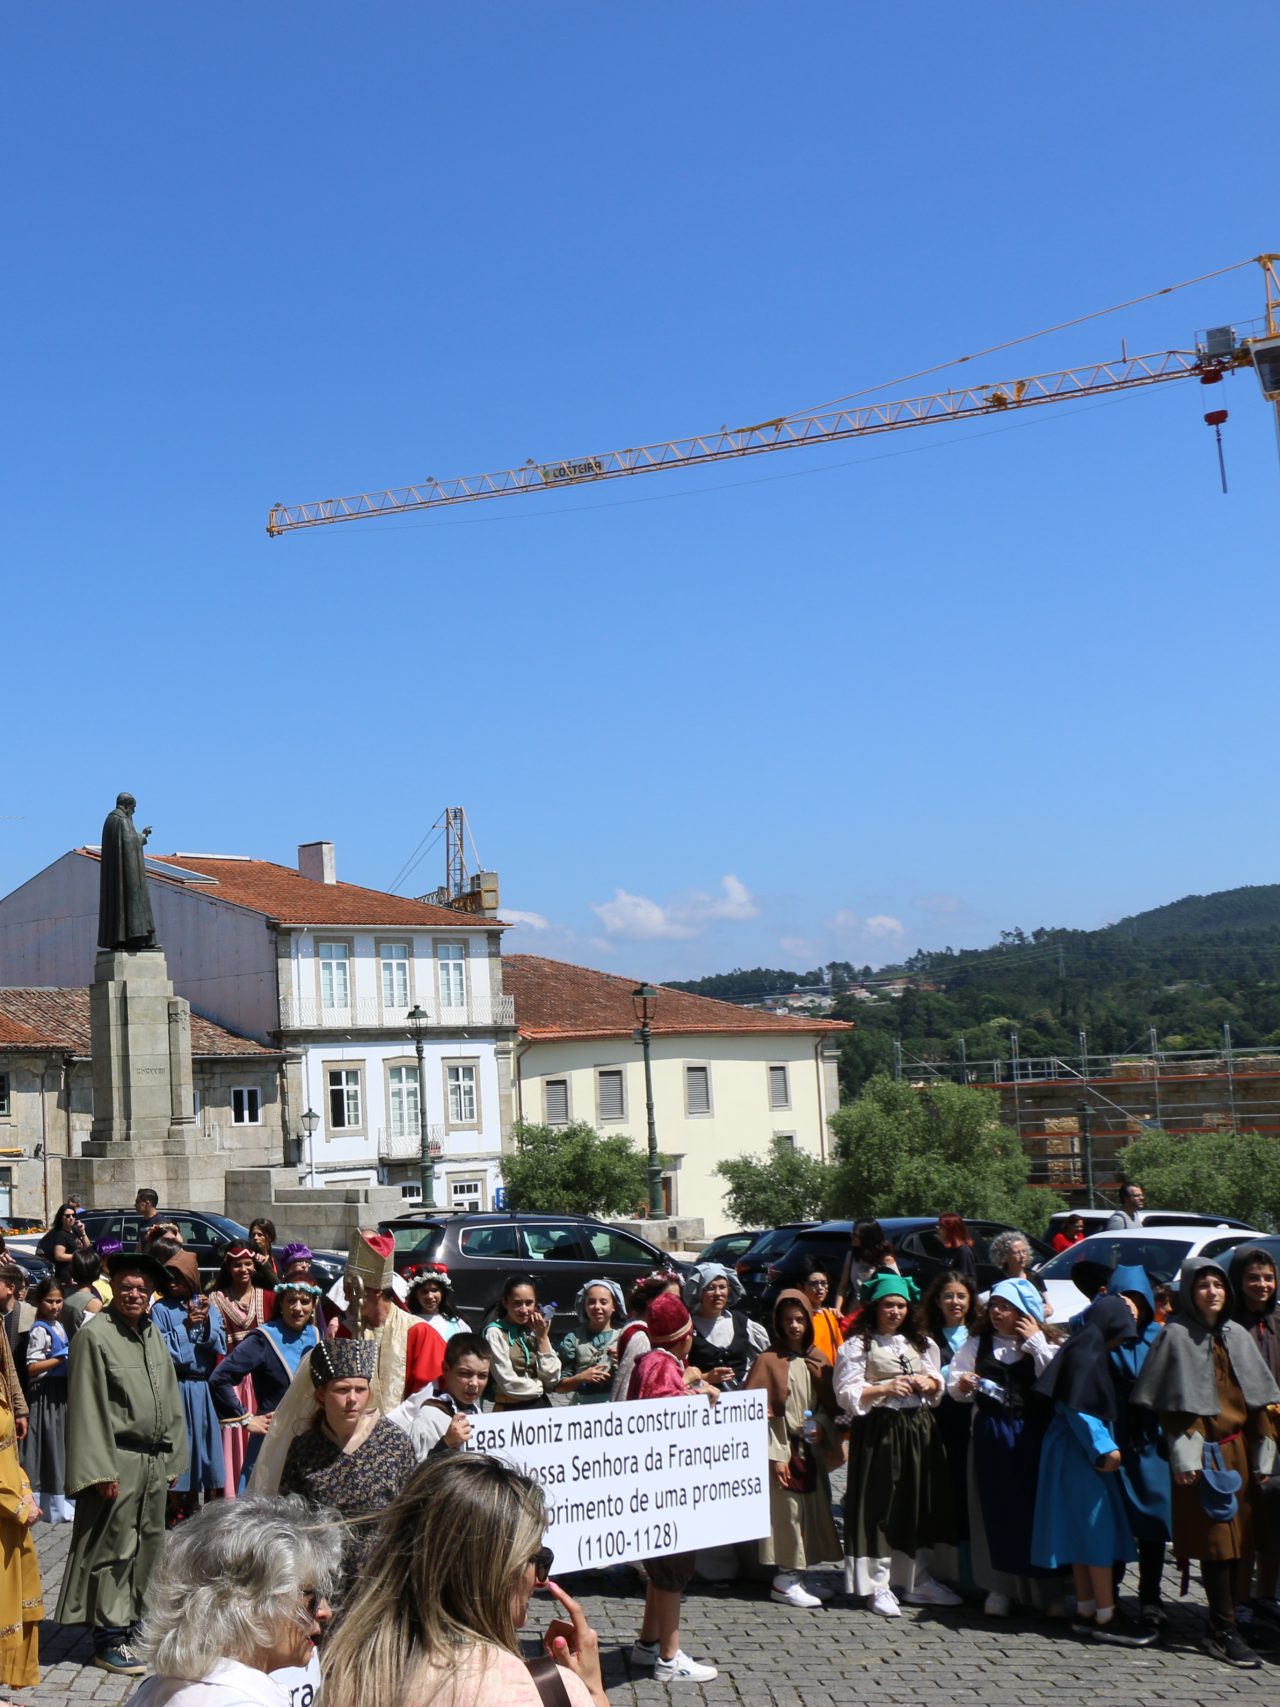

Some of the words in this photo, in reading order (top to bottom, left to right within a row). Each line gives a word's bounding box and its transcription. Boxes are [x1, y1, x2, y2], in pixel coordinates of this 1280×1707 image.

[510, 1417, 563, 1447] Moniz
[568, 1411, 623, 1440] manda
[627, 1404, 698, 1435] construir
[702, 1407, 710, 1426] a
[714, 1397, 764, 1425] Ermida
[572, 1452, 639, 1482] Senhora
[644, 1446, 663, 1472] da
[669, 1437, 750, 1470] Franqueira
[546, 1494, 624, 1532] primento
[629, 1488, 649, 1514] de
[655, 1489, 688, 1510] uma
[692, 1476, 762, 1510] promessa
[577, 1520, 678, 1567] (1100-1128)
